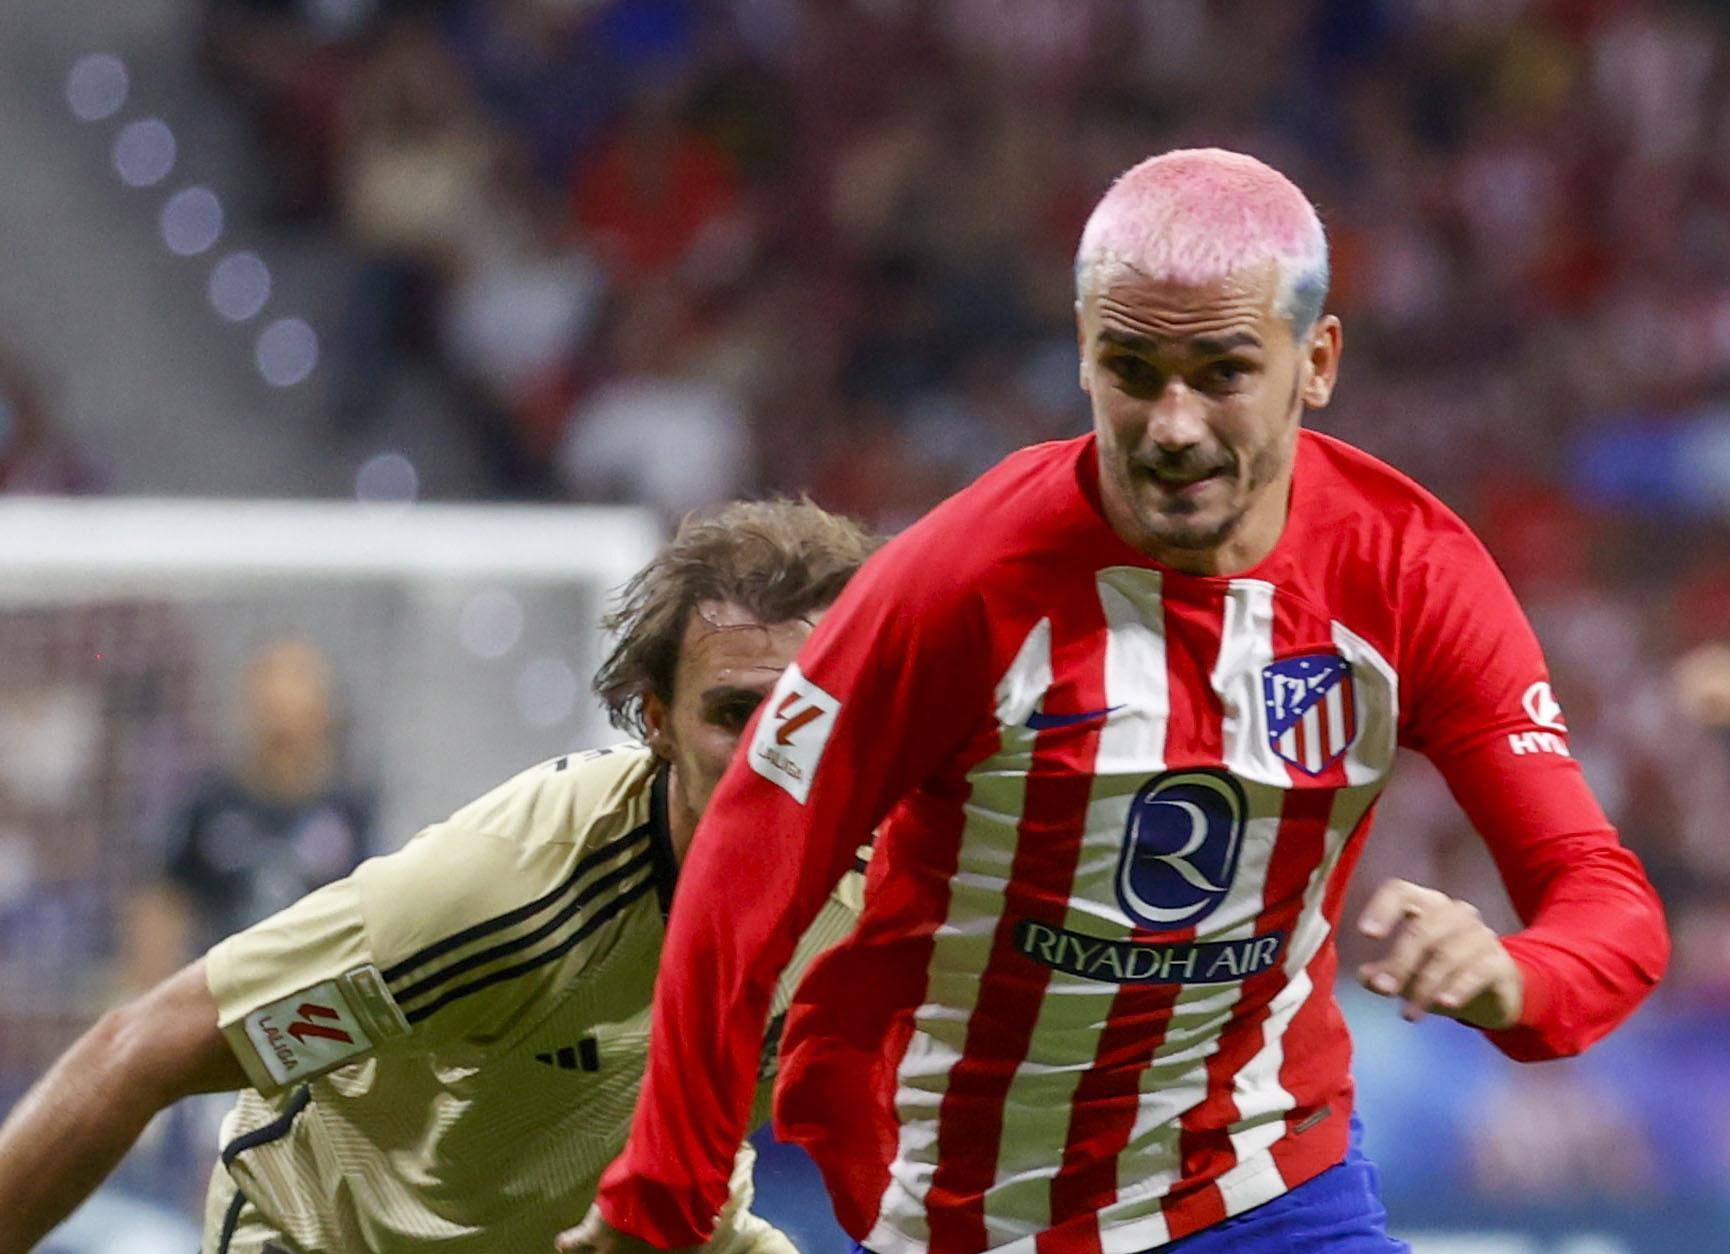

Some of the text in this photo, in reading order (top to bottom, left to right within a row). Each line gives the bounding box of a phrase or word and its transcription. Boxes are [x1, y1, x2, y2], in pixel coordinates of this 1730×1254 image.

[1023, 922, 1280, 979] RIYADH AIR
[258, 1015, 299, 1071] LALIGA
